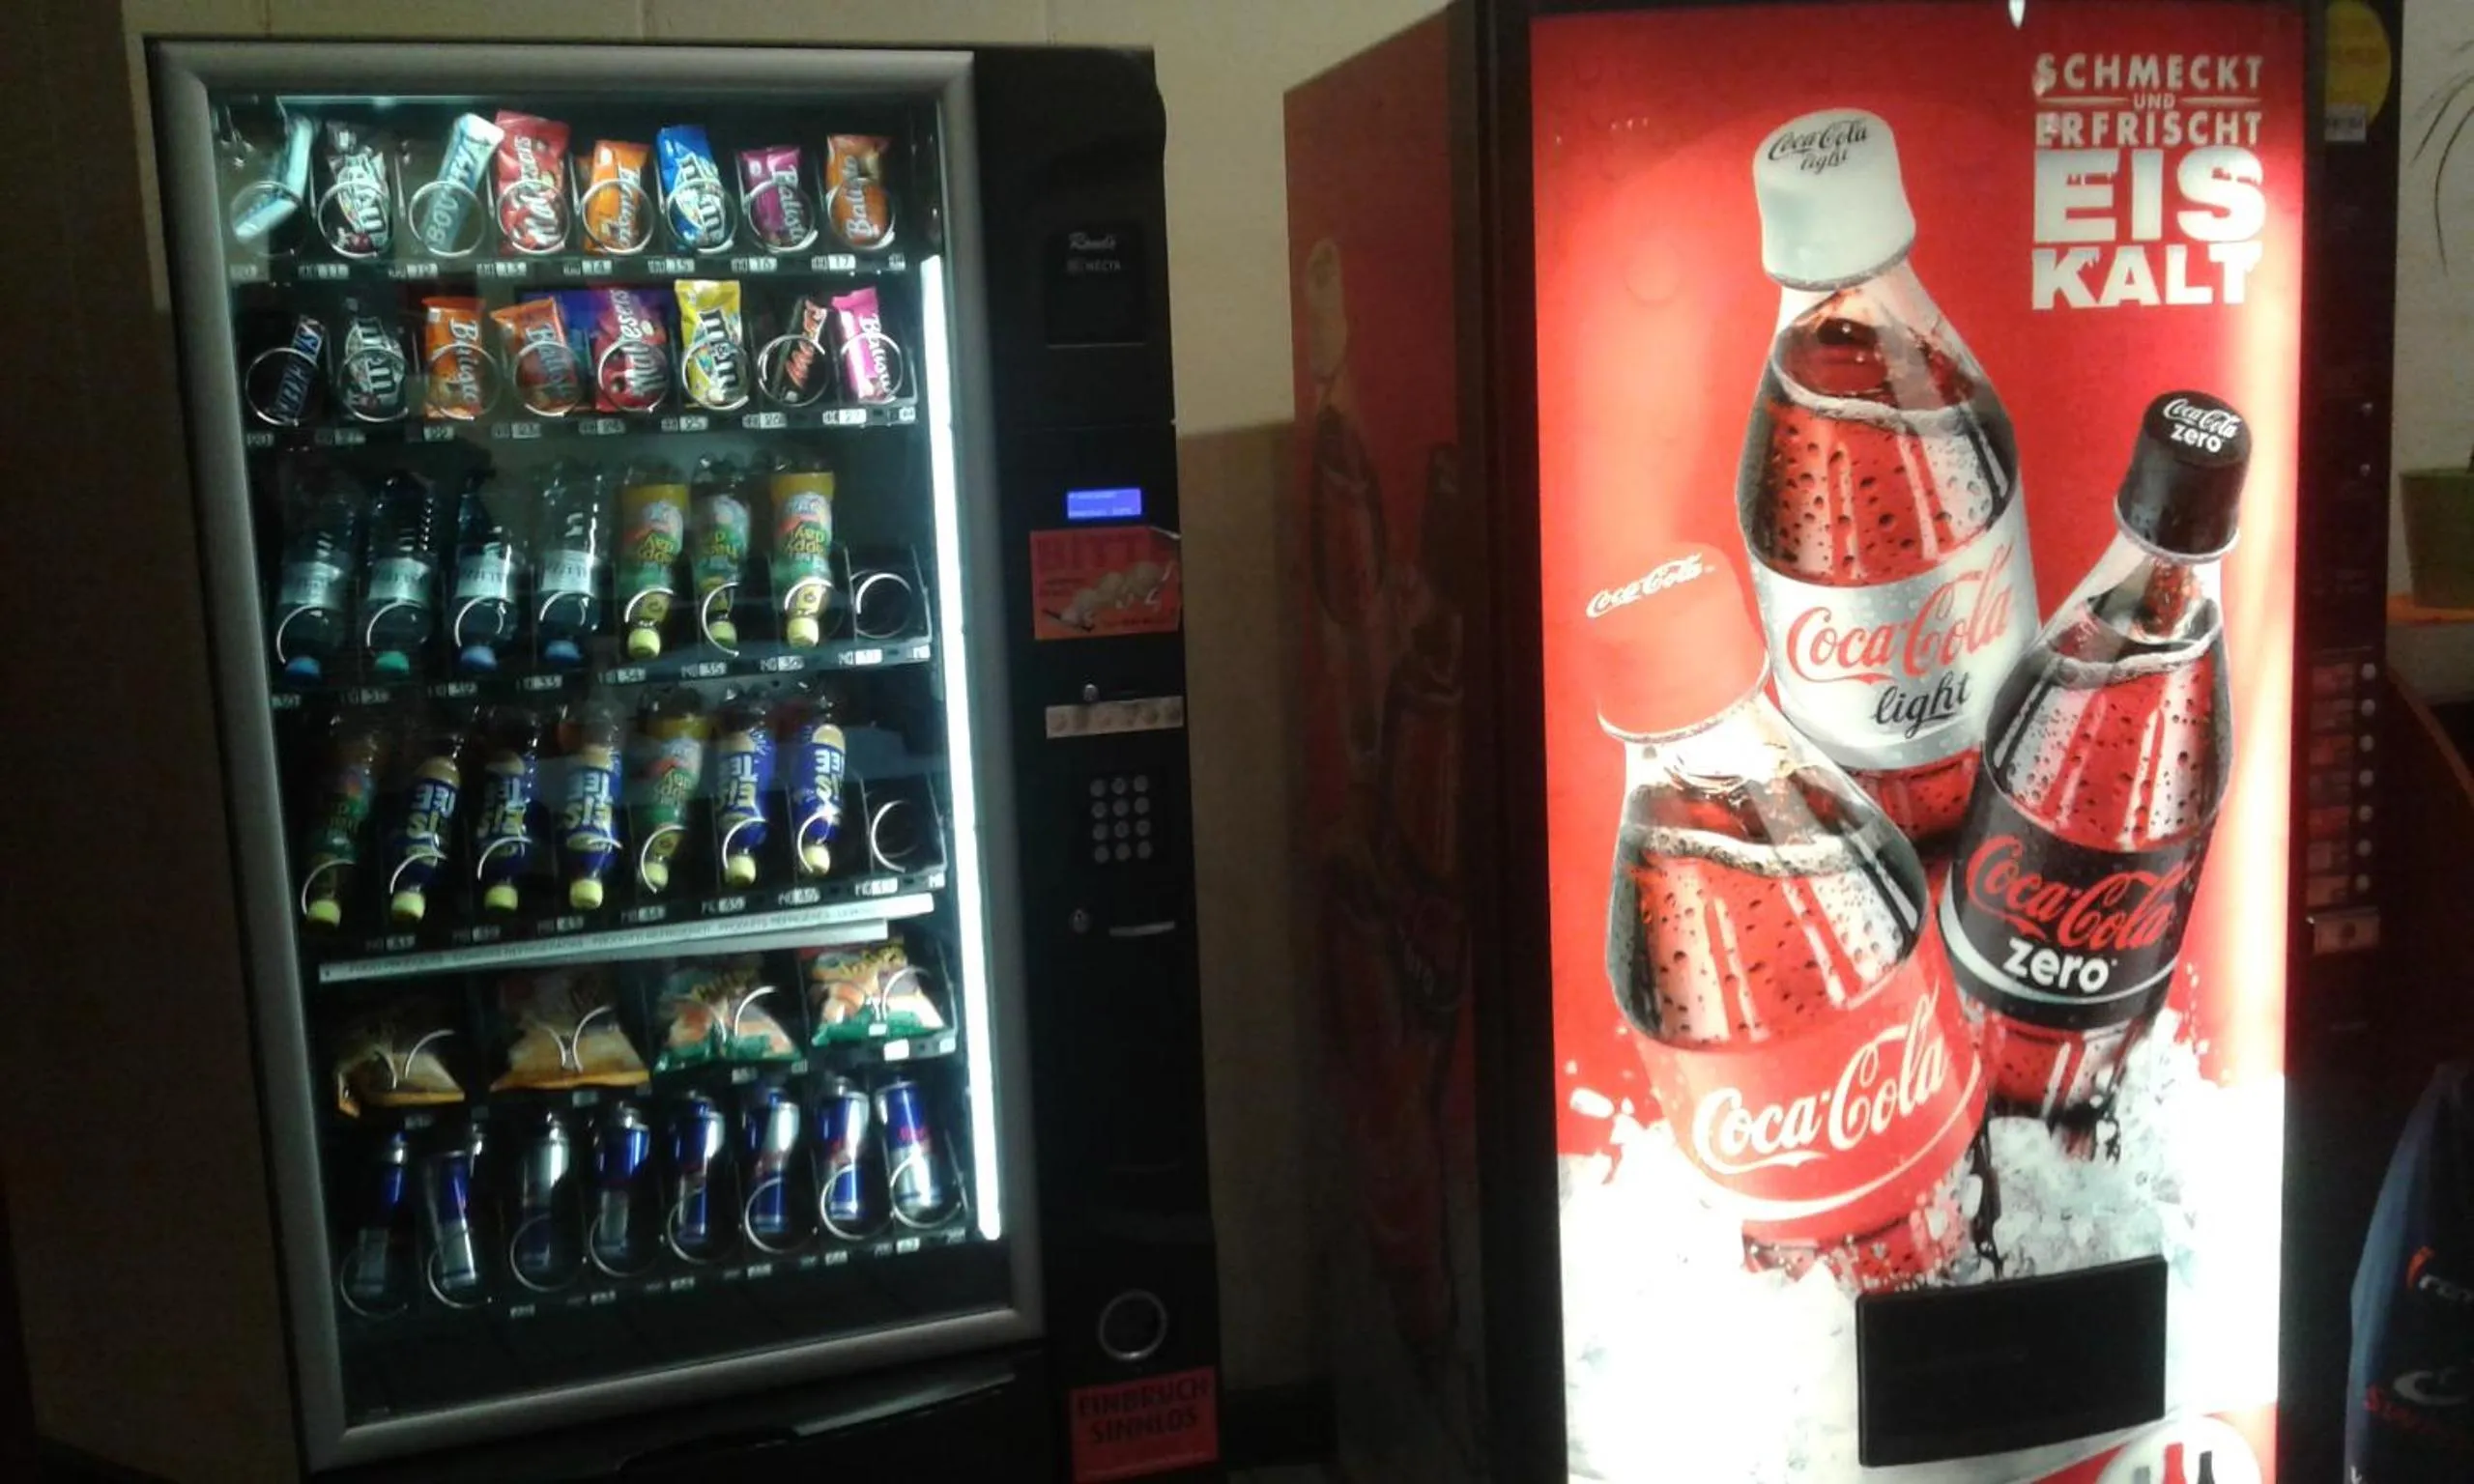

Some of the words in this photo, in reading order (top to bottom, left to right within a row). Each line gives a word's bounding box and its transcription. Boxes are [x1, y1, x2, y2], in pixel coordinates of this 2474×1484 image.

[2034, 53, 2263, 94] SCHMECKT
[2133, 92, 2176, 111] UND
[2034, 111, 2263, 147] ERFRISCHT
[2033, 145, 2267, 243] EIS
[2030, 241, 2263, 310] KALT
[2170, 423, 2223, 453] zero
[1872, 671, 1970, 740] light
[2001, 936, 2111, 993] zero
